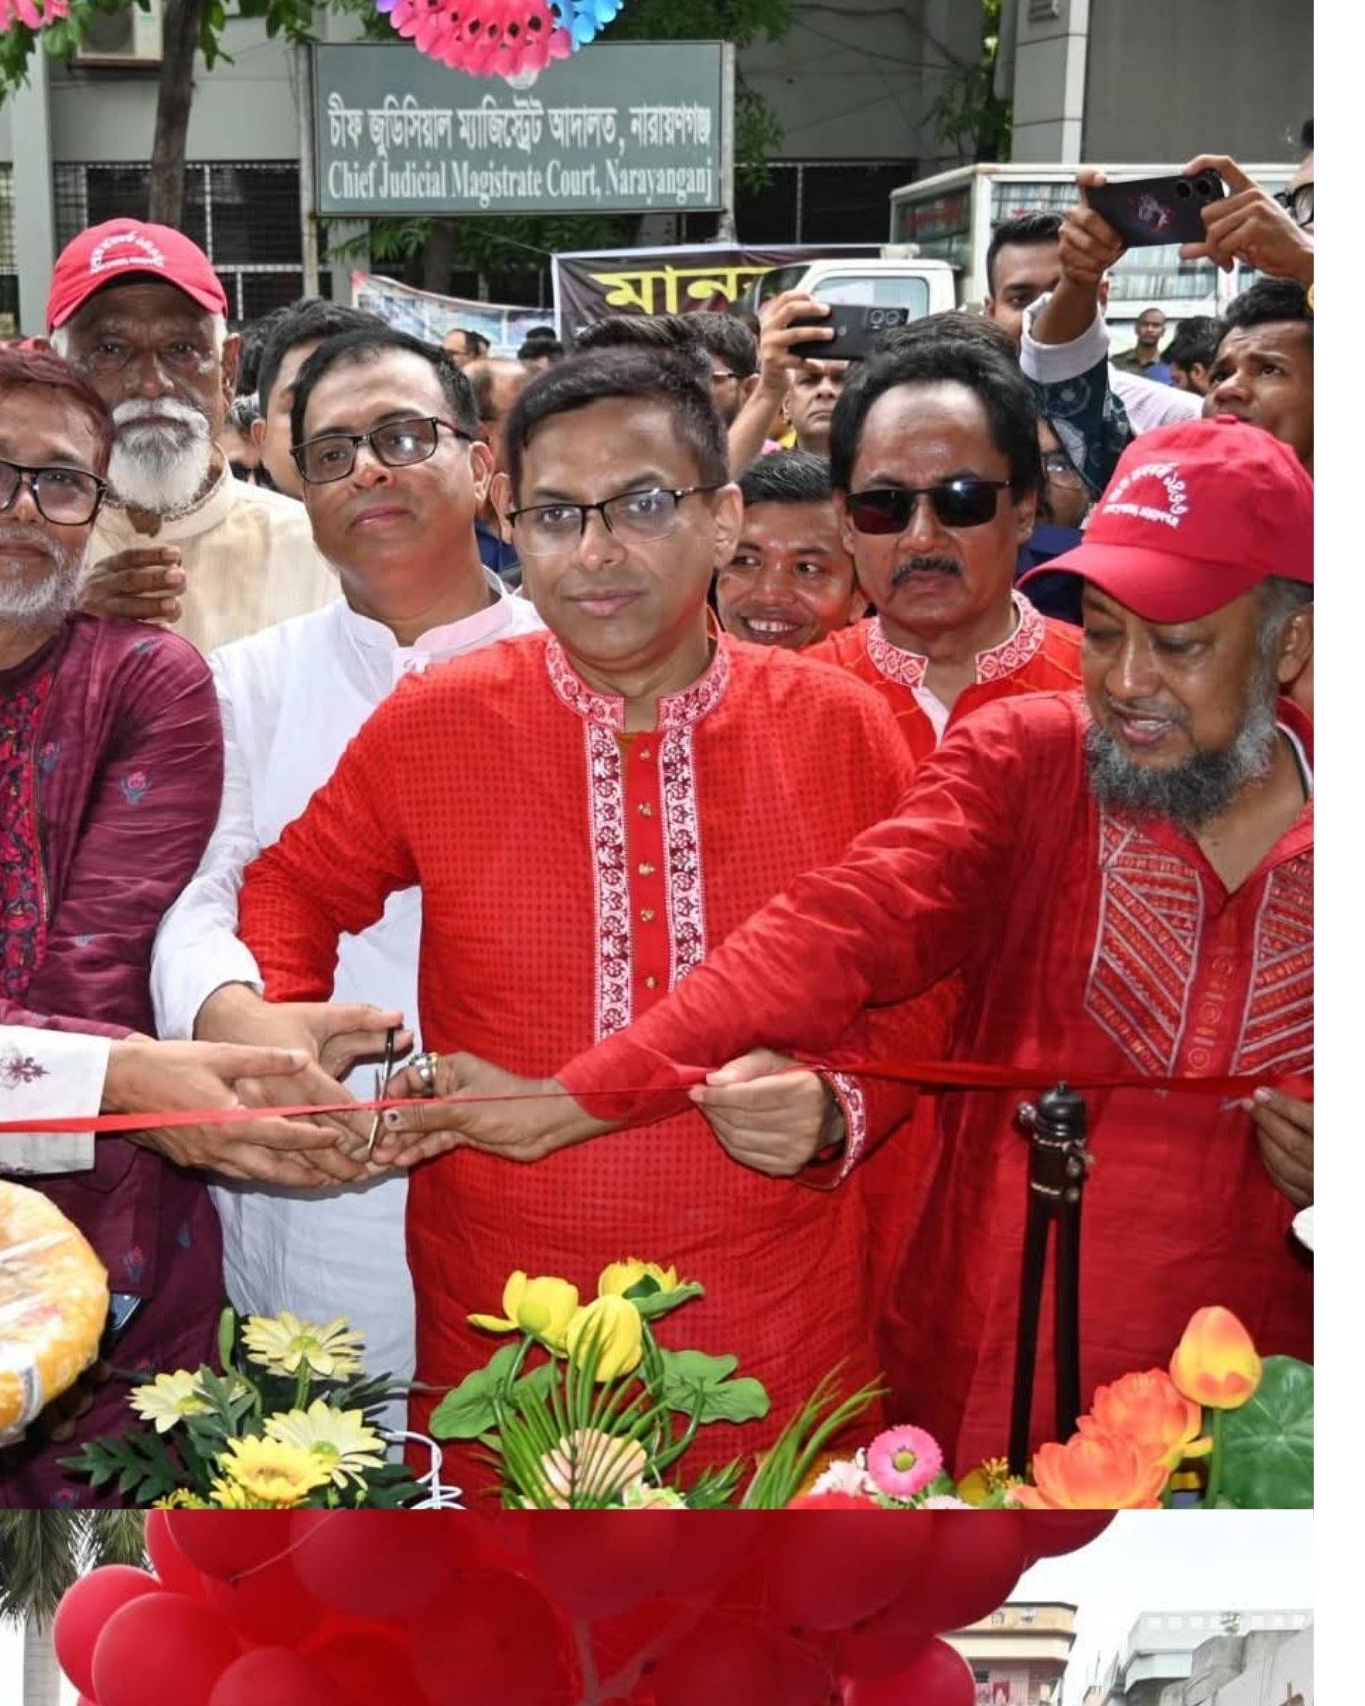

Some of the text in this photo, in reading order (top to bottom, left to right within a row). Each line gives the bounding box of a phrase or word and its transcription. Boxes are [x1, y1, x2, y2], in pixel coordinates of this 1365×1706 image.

[327, 91, 712, 163] চীফ জুডিসিয়াল ম্যাজিস্ট্রেট আদালত, নারায়ণগঞ্জ
[327, 157, 714, 209] Chief Judicial Magistrate Court, Narayanganj
[589, 263, 763, 317] মান
